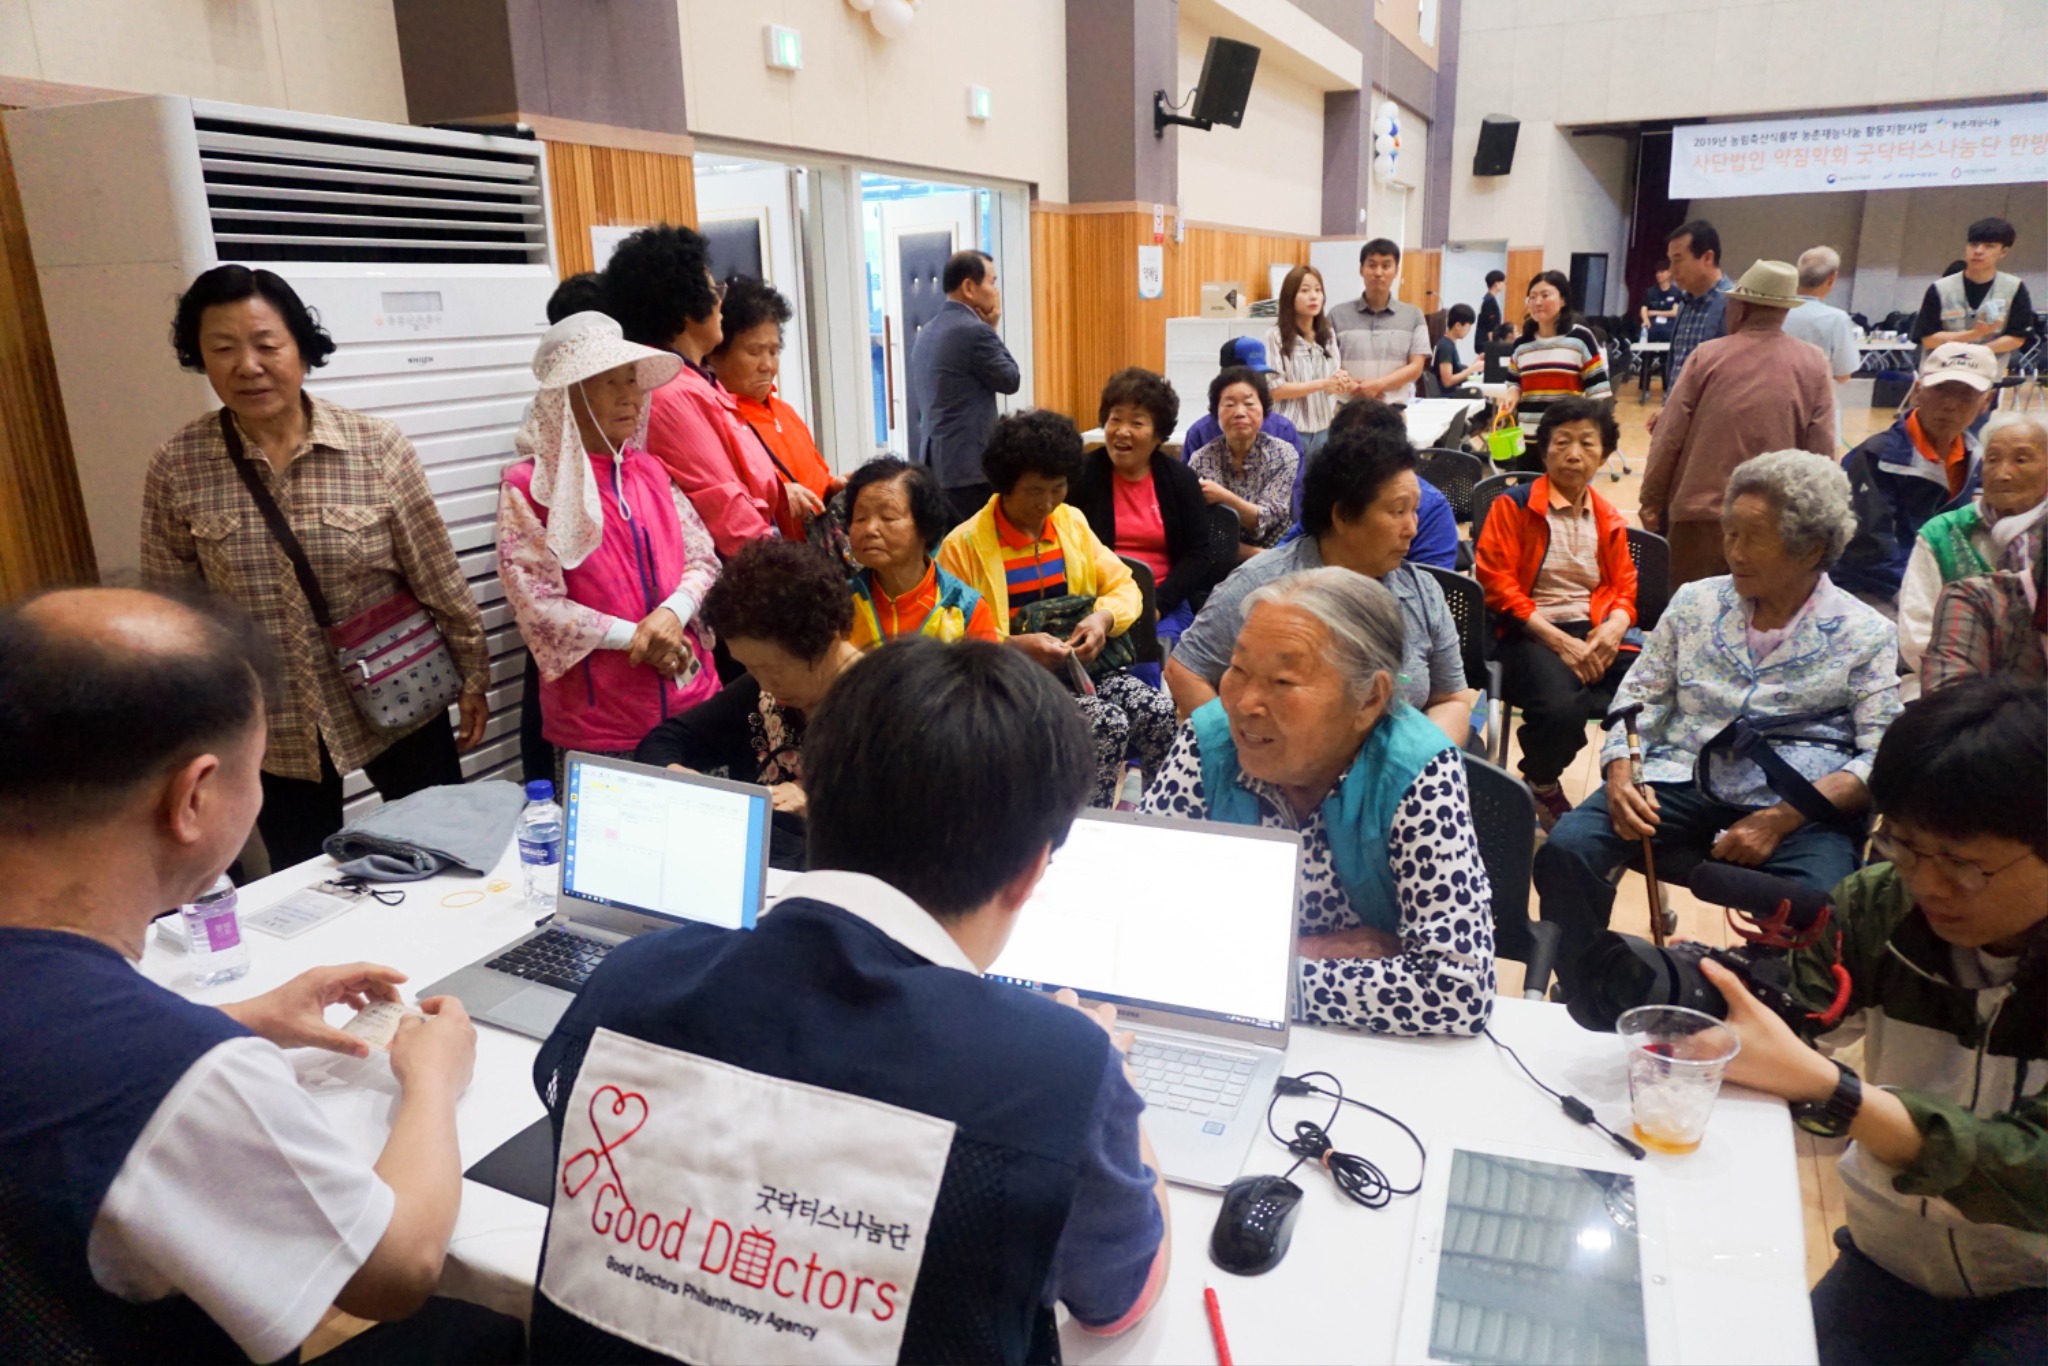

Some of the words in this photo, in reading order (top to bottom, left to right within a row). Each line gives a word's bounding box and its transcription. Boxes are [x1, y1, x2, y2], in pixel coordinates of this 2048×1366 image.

[1693, 149, 1766, 173] 사단법인
[1774, 144, 1849, 169] 약침학회
[1856, 135, 2001, 165] 굿닥터스나눔단
[1694, 136, 1727, 148] 2019년
[1866, 122, 1928, 137] 활동지원사업
[592, 1183, 692, 1262] Good
[756, 1185, 911, 1251] 굿닥터스나눔단
[606, 1254, 633, 1278] Good
[635, 1265, 679, 1295] Doctors
[682, 1282, 764, 1325] Philanthropy
[764, 1311, 818, 1342] Agency
